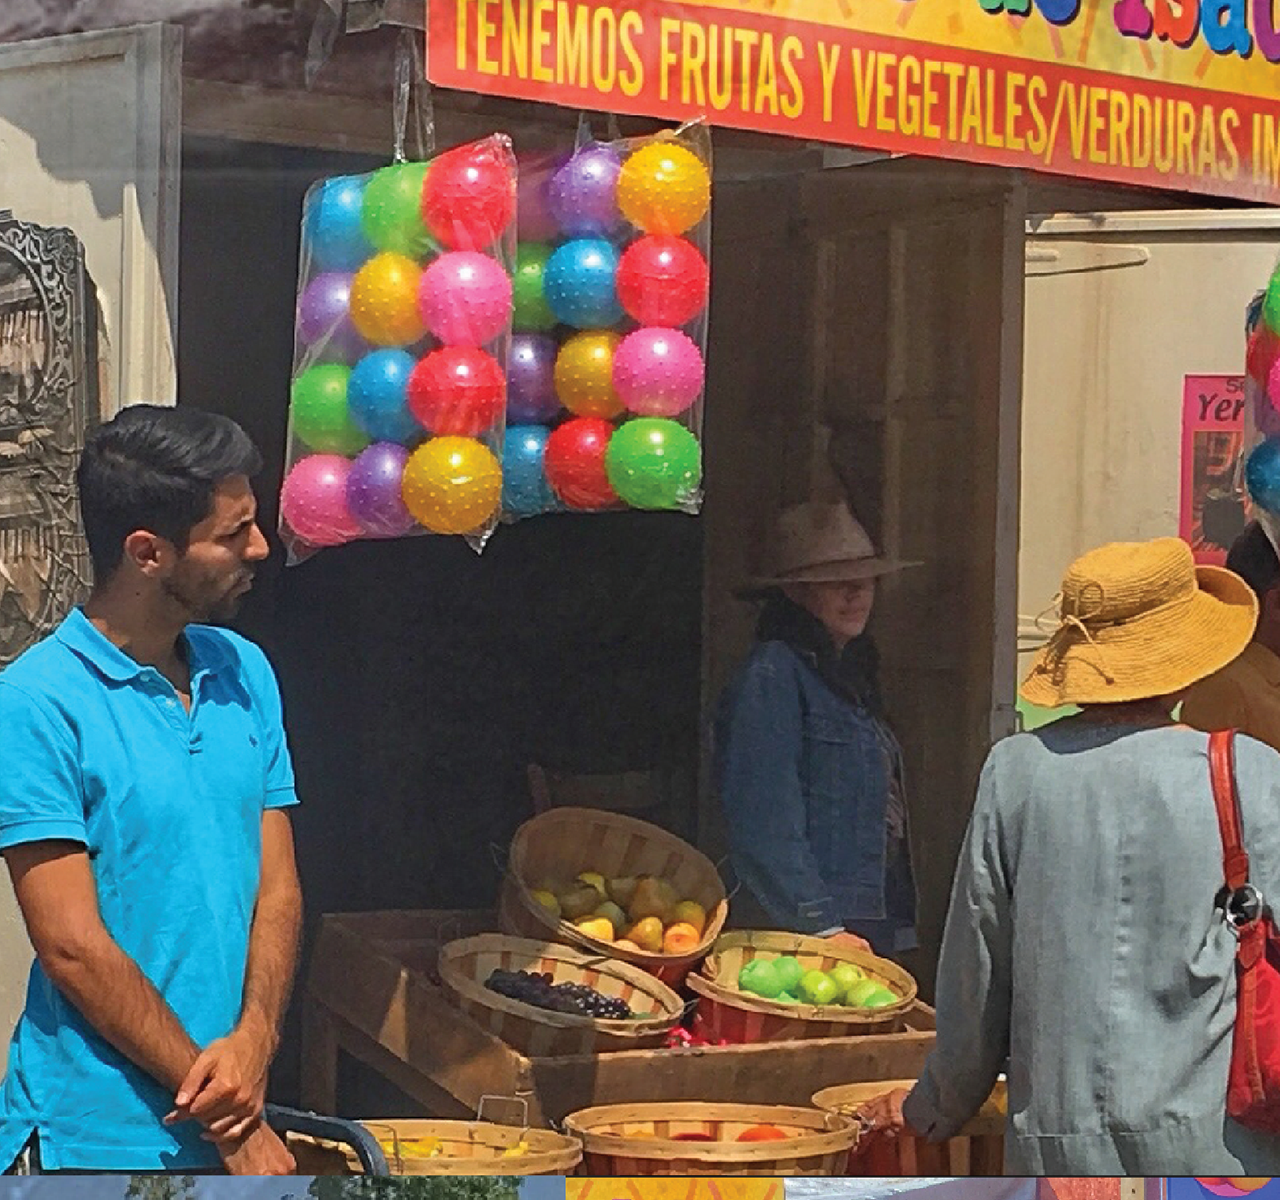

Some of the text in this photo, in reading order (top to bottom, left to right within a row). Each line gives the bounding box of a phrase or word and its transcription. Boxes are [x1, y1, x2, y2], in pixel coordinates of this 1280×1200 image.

[453, 0, 644, 97] TENEMOS
[660, 17, 805, 119] FRUTAS
[817, 40, 841, 122] Y
[851, 48, 1240, 182] VEGETALES/VERDURAS
